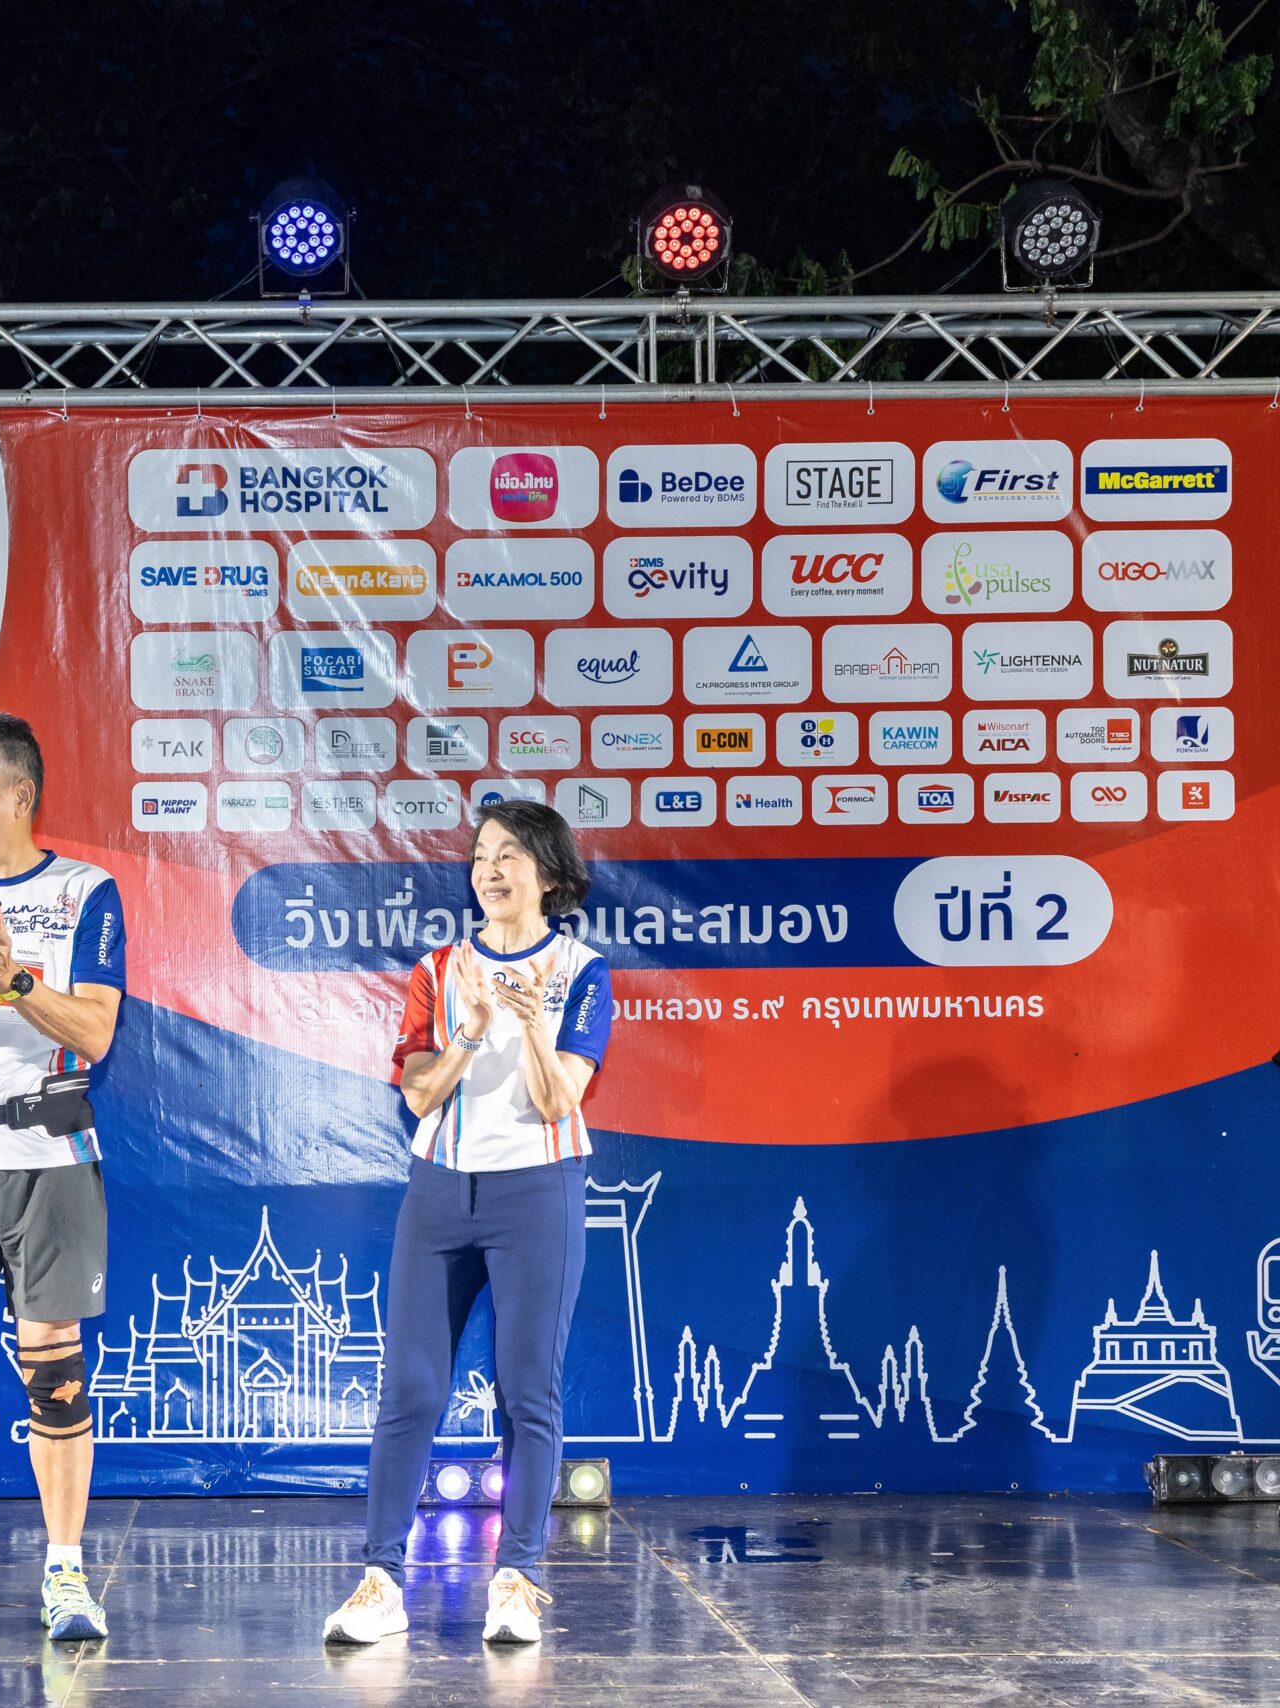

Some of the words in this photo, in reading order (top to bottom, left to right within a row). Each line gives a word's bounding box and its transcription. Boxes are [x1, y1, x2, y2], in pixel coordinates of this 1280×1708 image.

[240, 465, 388, 489] BANGKOK
[494, 471, 553, 489] เมืองไทย
[661, 471, 745, 493] BeDee
[796, 466, 881, 499] STAGE
[973, 469, 1060, 491] First
[1098, 472, 1215, 489] McGarrett
[240, 490, 388, 513] HOSPITAL
[661, 495, 701, 503] Powered
[703, 495, 714, 504] by
[717, 494, 745, 502] BDMS
[816, 501, 829, 509] Find
[831, 500, 842, 509] The
[843, 500, 857, 509] Real
[140, 566, 197, 586] SAVE
[204, 566, 268, 586] DRUG
[975, 563, 1011, 577] usa
[551, 571, 582, 586] 500
[985, 571, 1051, 599] pulses
[790, 588, 809, 597] Every
[835, 588, 855, 597] every
[856, 587, 884, 595] moment
[303, 654, 361, 665] POCARI
[577, 650, 640, 680] equal
[1000, 654, 1082, 667] LIGHTENNA
[1133, 658, 1160, 671] NUT
[1161, 658, 1204, 671] NATUR
[303, 665, 355, 675] SWEAT
[173, 676, 214, 687] SNAKE
[175, 688, 214, 697] BRAND
[883, 726, 939, 739] KAWIN
[987, 722, 1029, 731] Wilsonart
[509, 731, 545, 744] SCG
[601, 732, 662, 746] ONNEX
[701, 732, 749, 749] Q-CON
[158, 741, 204, 757] TAK
[509, 745, 570, 755] CLEANERGY
[883, 740, 938, 750] CARECOM
[978, 738, 1031, 751] AICA
[222, 798, 257, 807] PARAZZO
[659, 795, 699, 808] L&E
[755, 797, 793, 808] Health
[920, 792, 951, 805] TOA
[994, 790, 1051, 802] VISPAC
[161, 799, 197, 807] NIPPON
[393, 802, 448, 814] COTTO
[164, 806, 191, 814] PAINT
[935, 871, 1013, 942] ปีที่
[1035, 893, 1069, 941] 2
[12, 926, 28, 935] 2025
[98, 912, 112, 966] BANGKOK
[802, 994, 1044, 1029] กรุงเทพมหานคร
